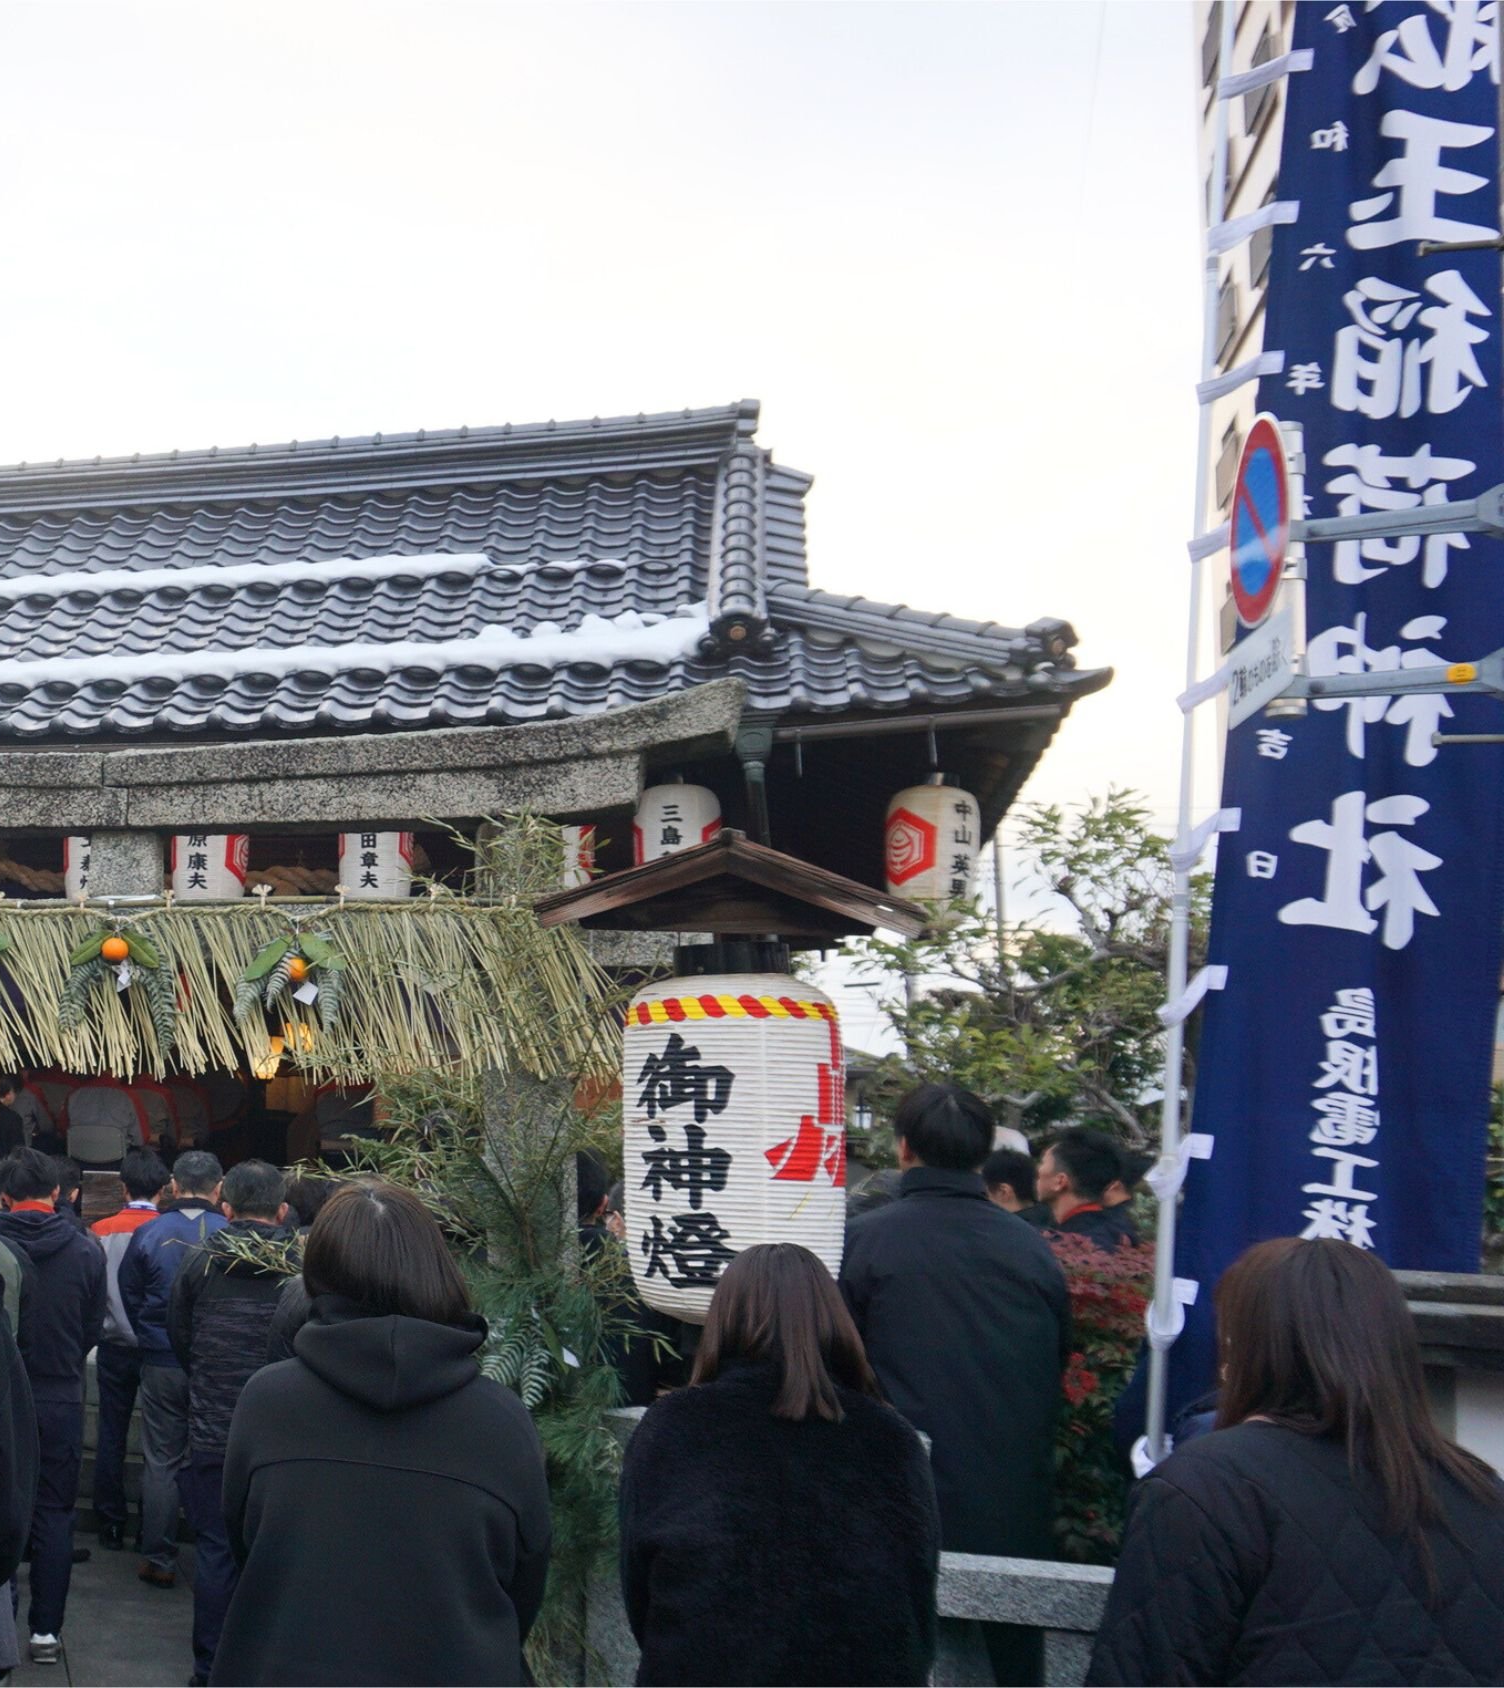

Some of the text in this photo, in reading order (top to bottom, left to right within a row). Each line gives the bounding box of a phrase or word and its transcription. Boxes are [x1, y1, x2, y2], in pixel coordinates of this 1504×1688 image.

[660, 804, 684, 856] 三島
[636, 1033, 740, 1290] 御神燈
